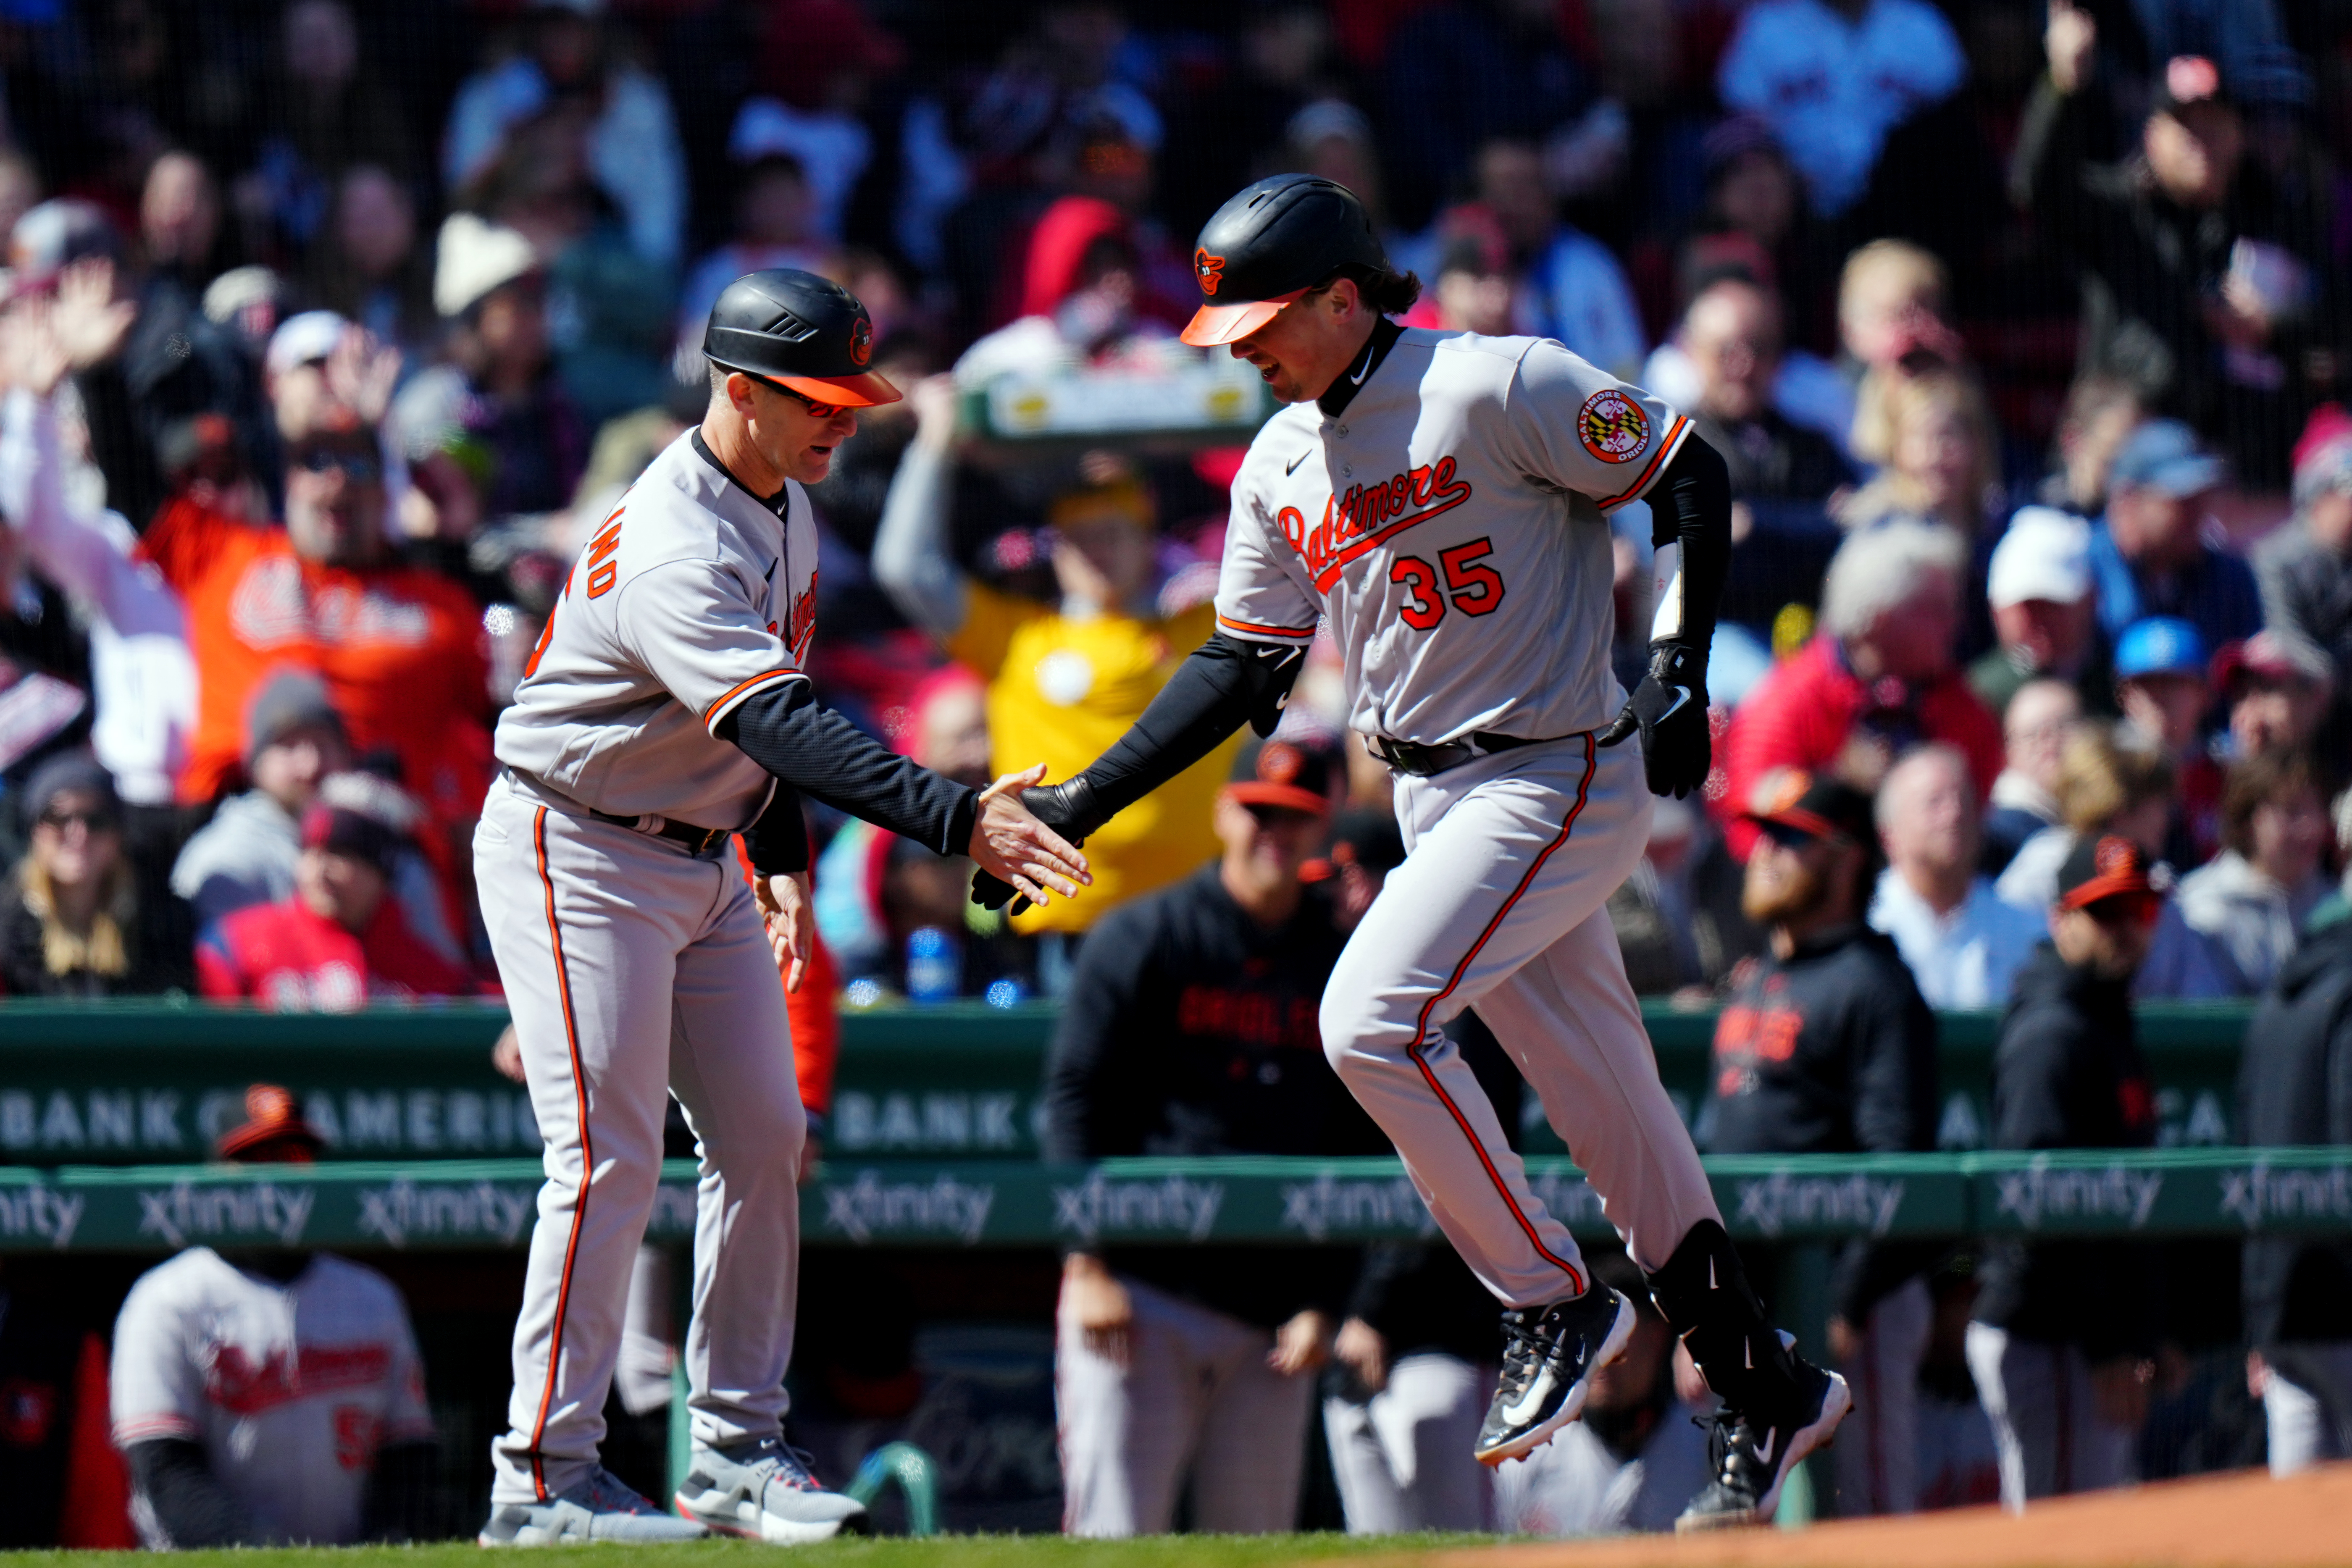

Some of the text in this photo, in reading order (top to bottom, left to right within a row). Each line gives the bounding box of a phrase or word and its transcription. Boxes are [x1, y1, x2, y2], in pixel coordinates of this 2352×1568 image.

[1579, 391, 1621, 444] BALTIMORE
[1618, 421, 1649, 461] ORIOLES
[1278, 455, 1471, 598] Baltimore
[1389, 536, 1505, 631] 35
[2, 1089, 181, 1152] BANK
[835, 1093, 1017, 1151] BANK
[139, 1175, 315, 1248] xfinity
[358, 1174, 530, 1250] xfinity
[823, 1169, 995, 1246] xfinity
[1054, 1169, 1223, 1244] xfinity
[1737, 1166, 1904, 1237] xfinity
[1999, 1154, 2161, 1229] xfinity
